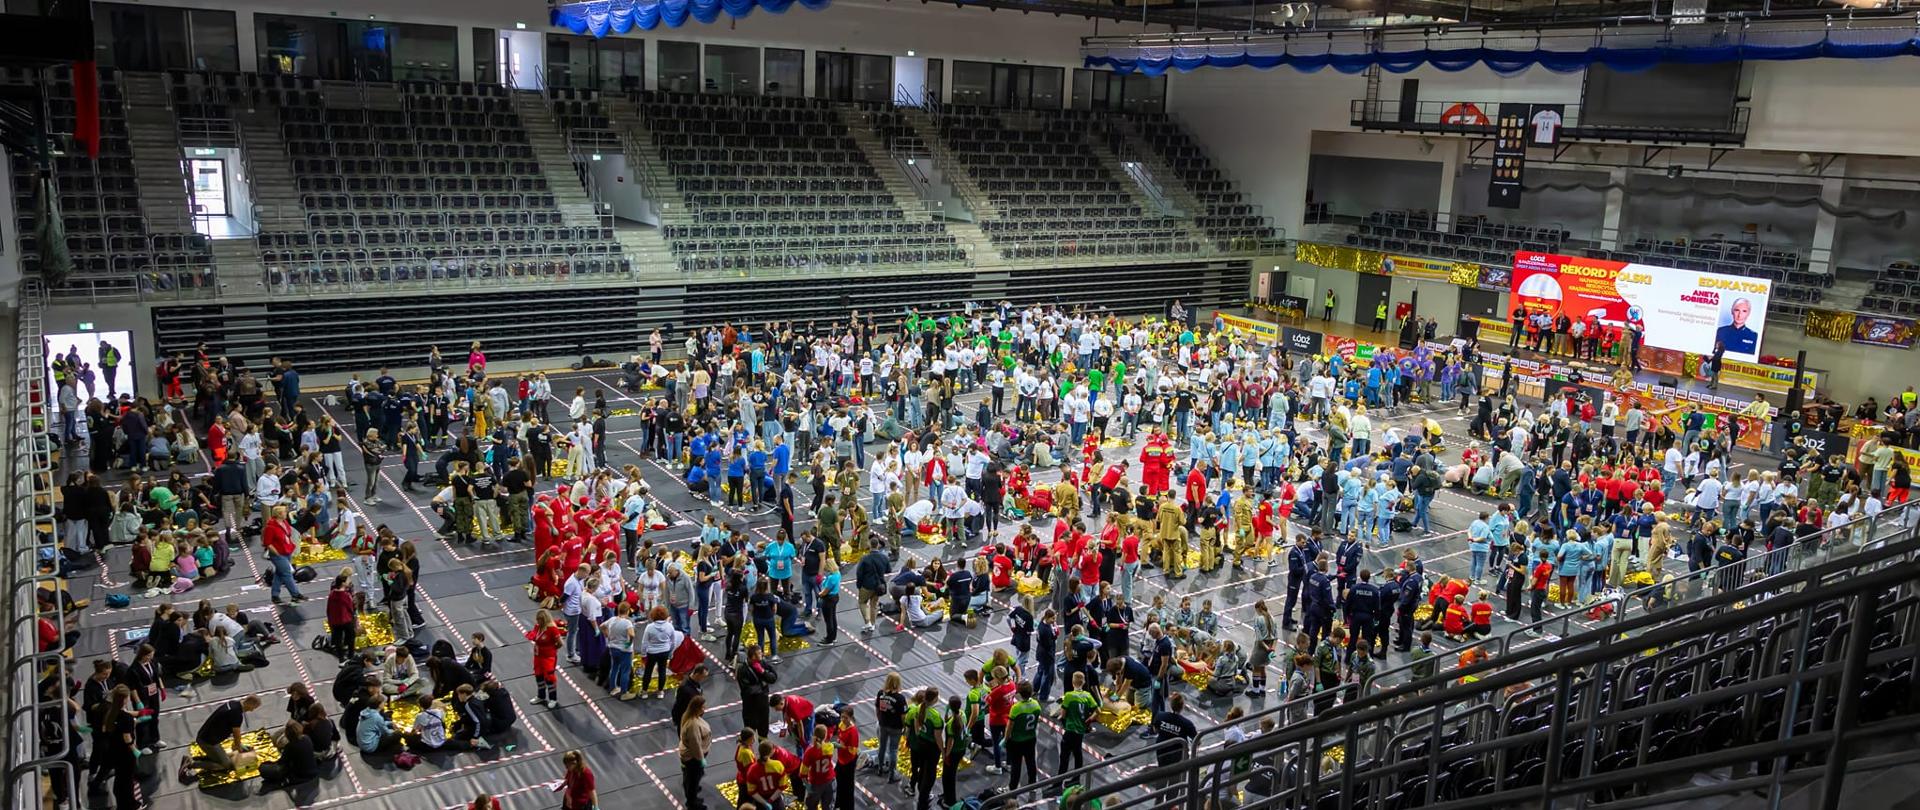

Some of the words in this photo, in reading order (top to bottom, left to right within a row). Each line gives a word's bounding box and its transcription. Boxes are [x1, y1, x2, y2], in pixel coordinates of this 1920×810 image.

[1542, 121, 1550, 131] 14
[1488, 271, 1505, 282] 32
[1560, 264, 1607, 278] REKORD
[1609, 270, 1652, 285] POLSKI
[1698, 277, 1768, 294] EDUKATOR
[1680, 294, 1719, 305] SOBIERAJ
[1692, 289, 1720, 299] ANETA
[1870, 326, 1891, 338] 32
[1292, 333, 1311, 345] ŁÓDŹ
[1742, 366, 1769, 378] RESTART
[1356, 589, 1373, 597] POLICJA
[1025, 713, 1035, 730] 2
[1160, 720, 1181, 733] ZSEU
[816, 758, 830, 773] 12
[760, 775, 775, 791] 11
